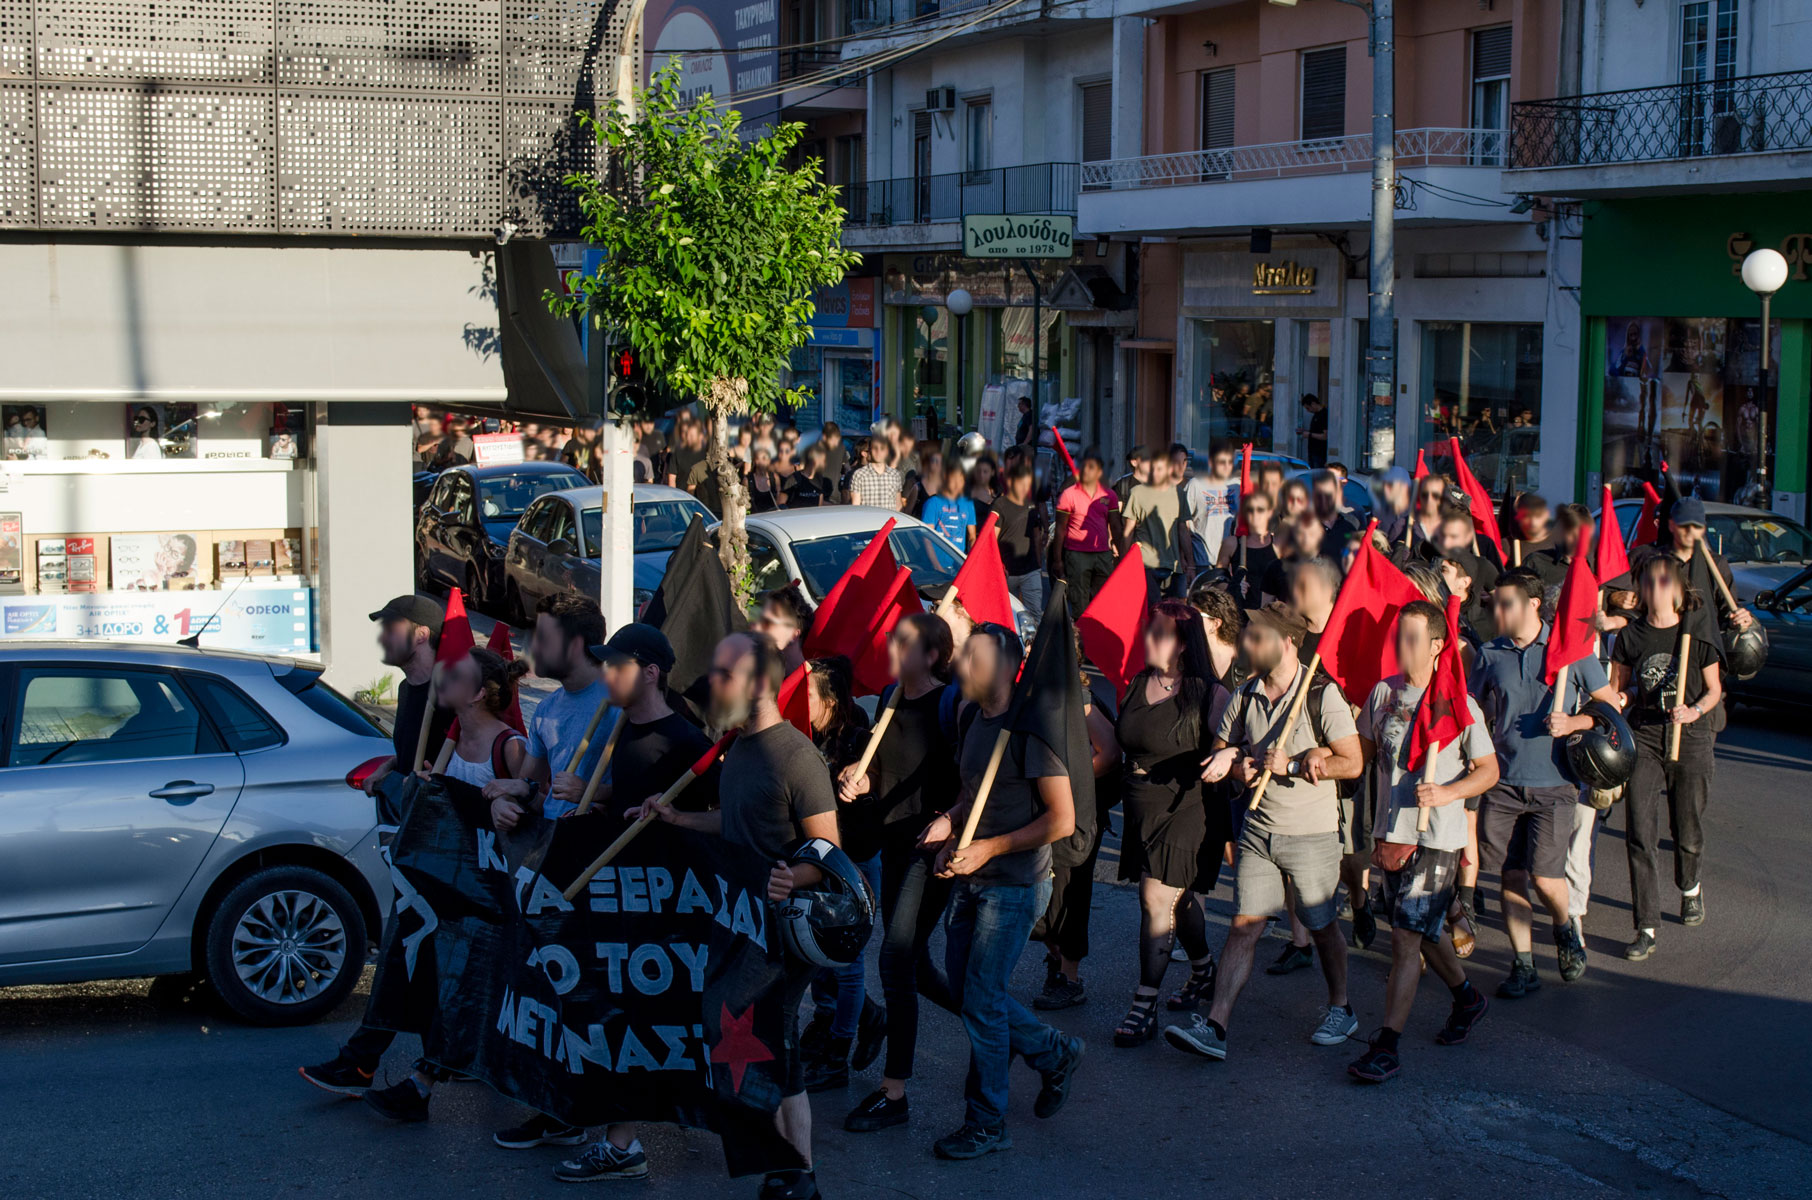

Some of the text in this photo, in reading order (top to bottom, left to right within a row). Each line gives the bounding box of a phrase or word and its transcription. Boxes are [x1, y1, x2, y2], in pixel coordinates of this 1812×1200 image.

[735, 0, 775, 31] ΤΑΧΥΡΥΘΜΑ
[969, 217, 1070, 248] λουλούδια
[1029, 244, 1055, 254] 1978
[1252, 260, 1316, 287] Ντάλια
[245, 604, 290, 615] ODEON
[76, 624, 101, 636] 3+1
[153, 614, 169, 635] &
[174, 608, 191, 636] 1
